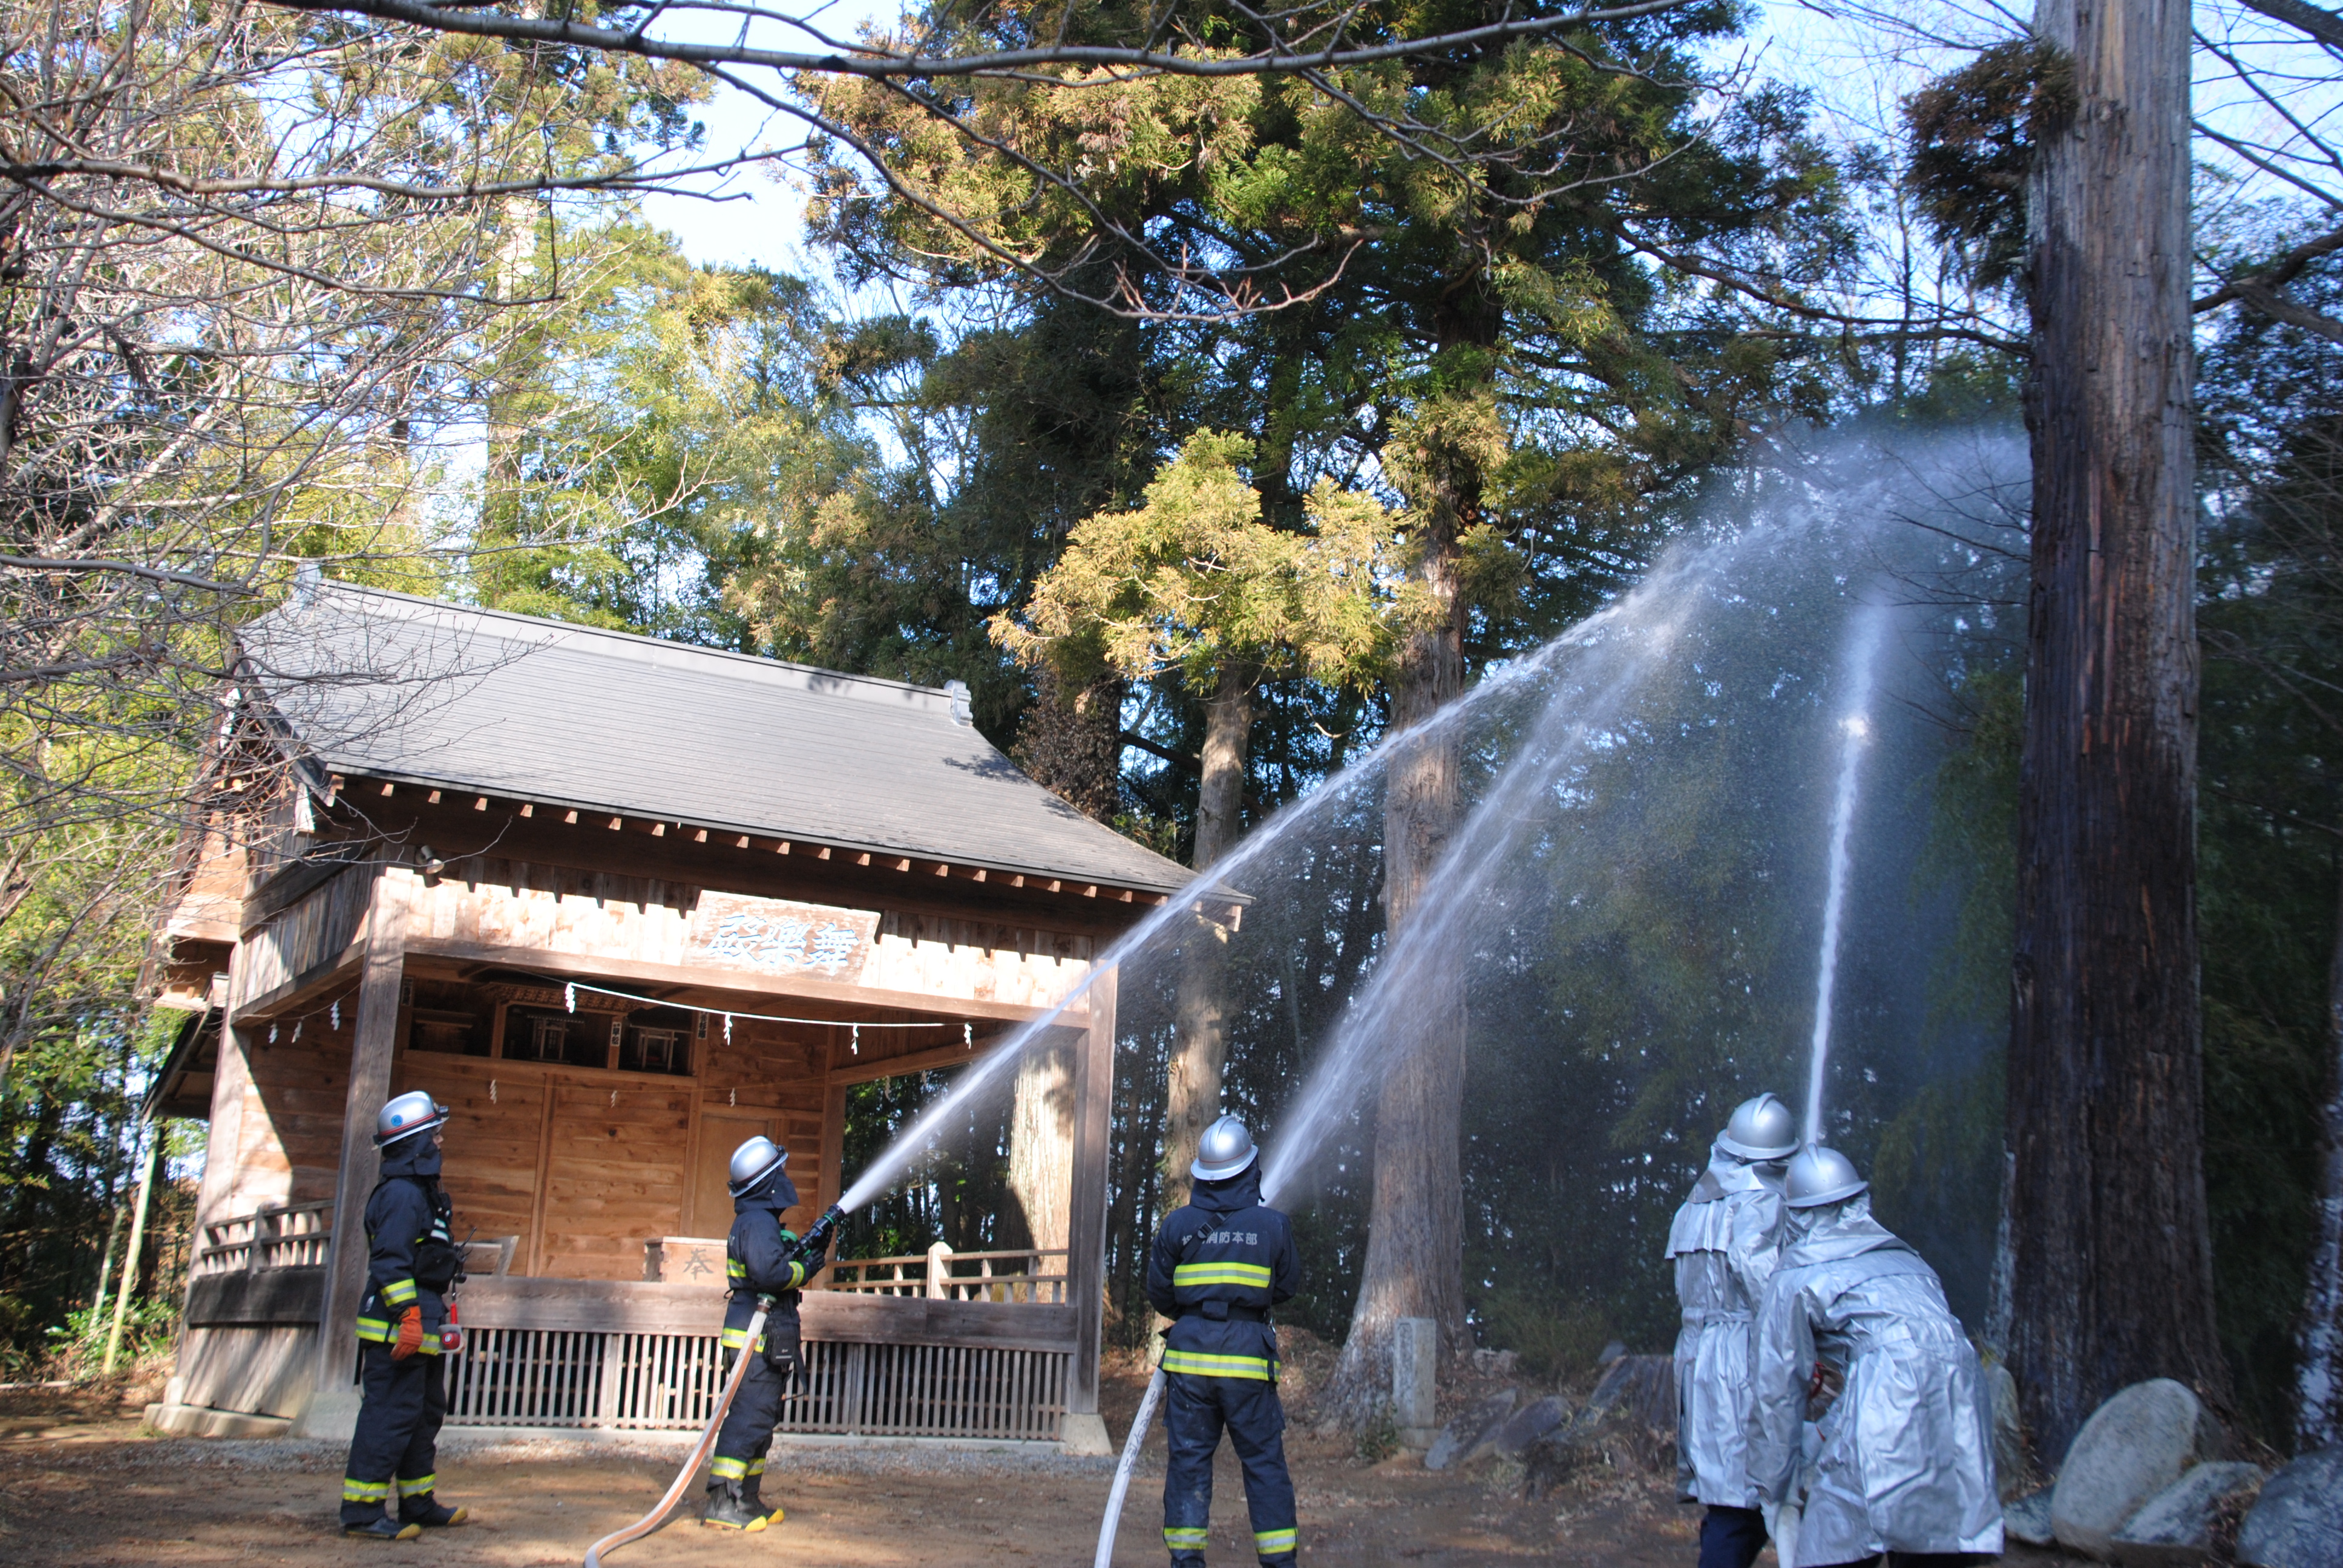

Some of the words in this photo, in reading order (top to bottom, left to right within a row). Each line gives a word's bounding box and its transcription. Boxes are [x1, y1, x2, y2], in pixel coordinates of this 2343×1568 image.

[1182, 1231, 1257, 1246] 消防本部
[683, 1248, 714, 1281] 奉
